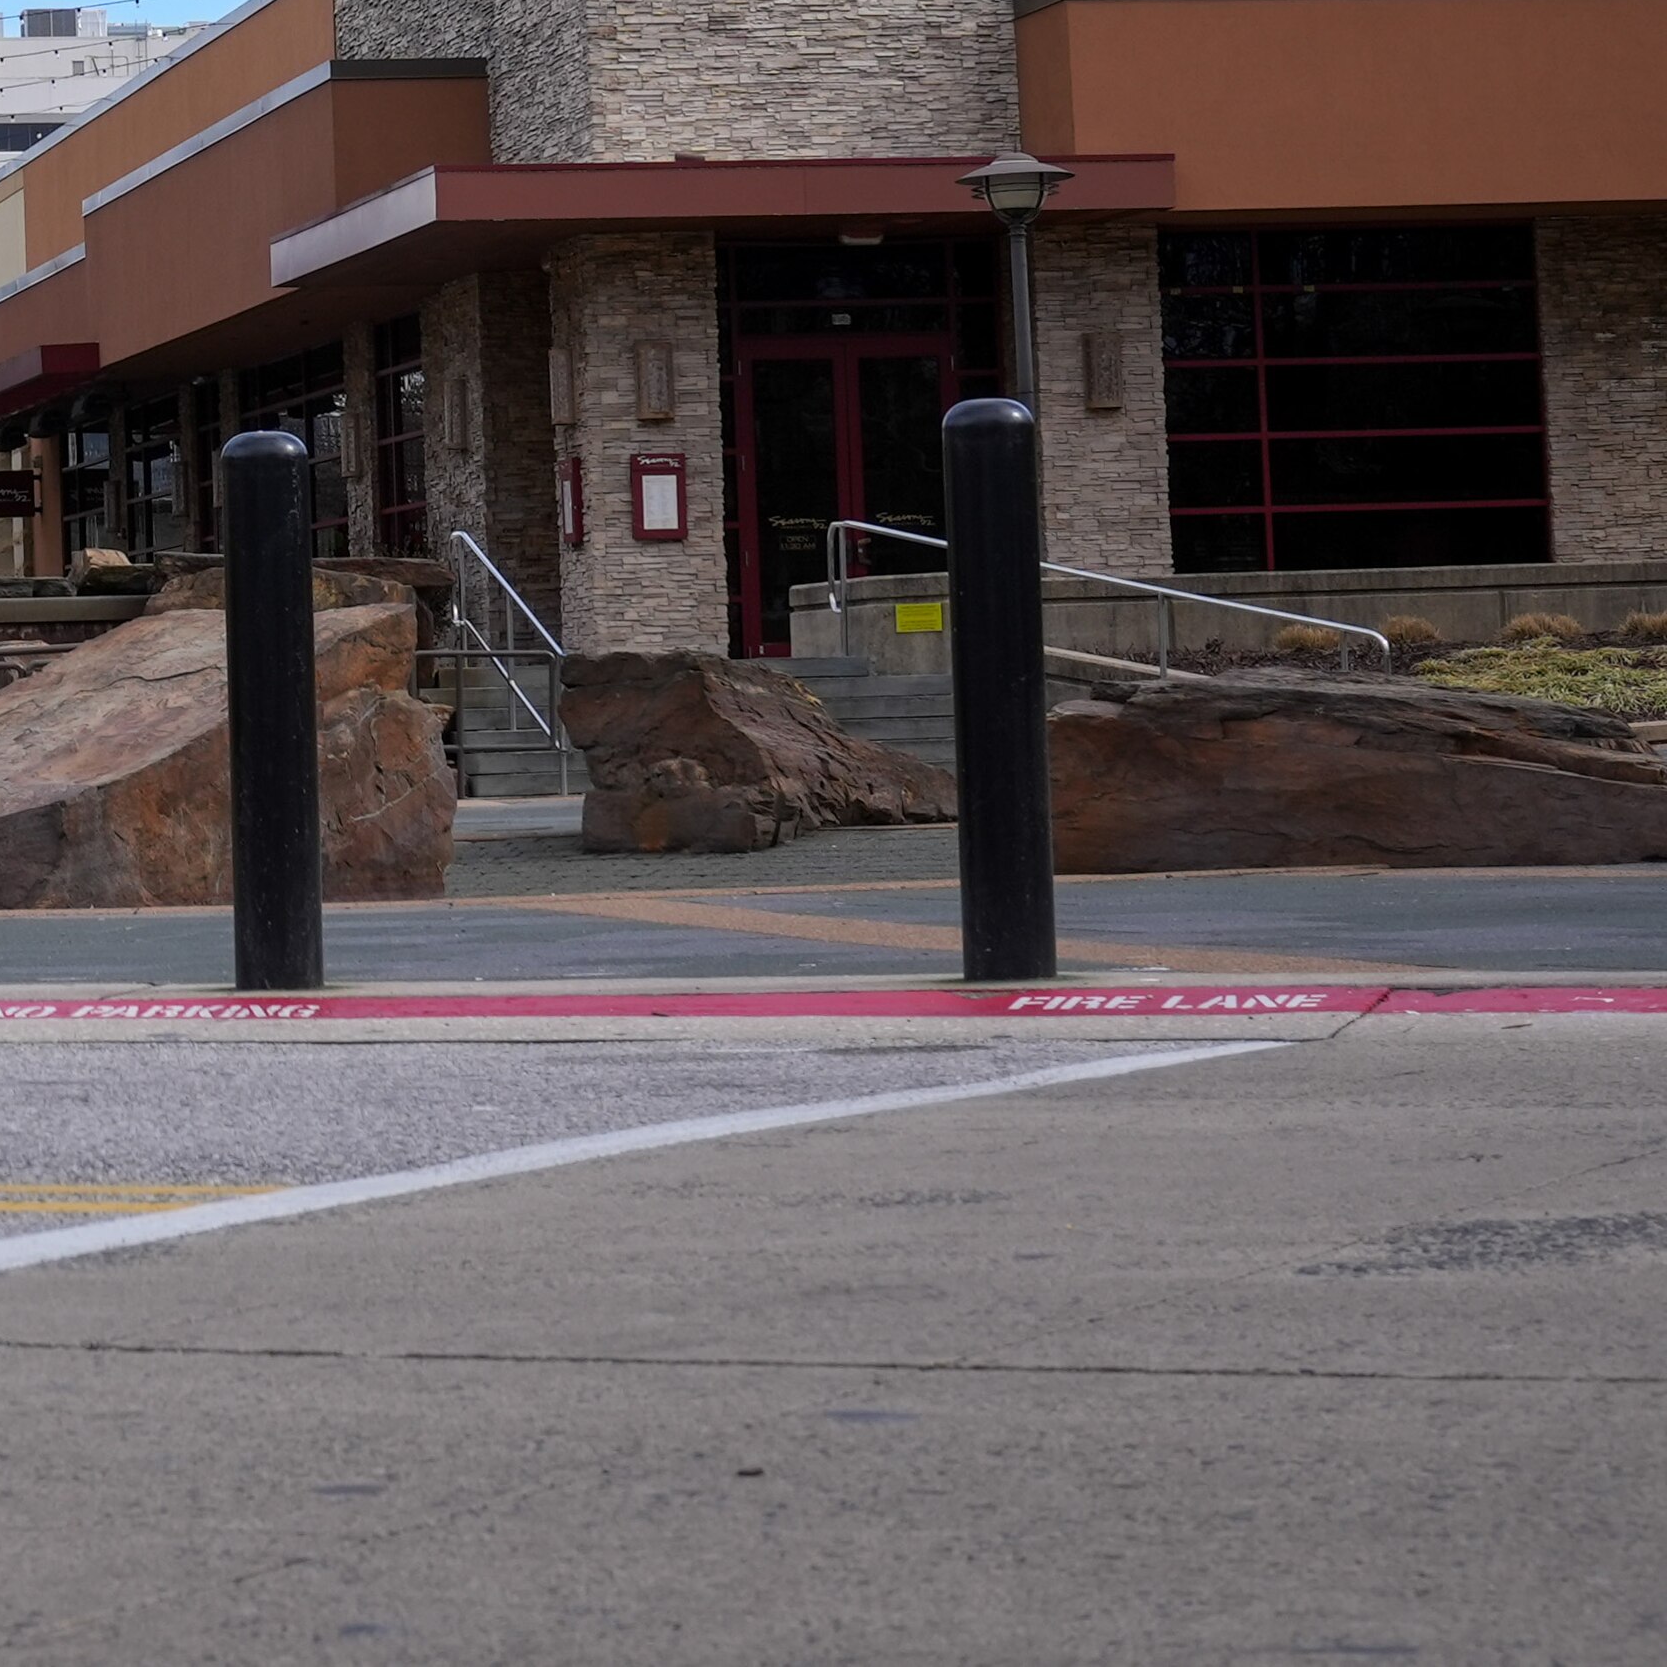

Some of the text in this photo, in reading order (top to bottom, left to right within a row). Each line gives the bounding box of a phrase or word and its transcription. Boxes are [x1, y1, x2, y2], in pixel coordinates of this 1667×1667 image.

[1008, 994, 1328, 1010] FIRE LANE
[70, 1003, 321, 1019] PARKING
